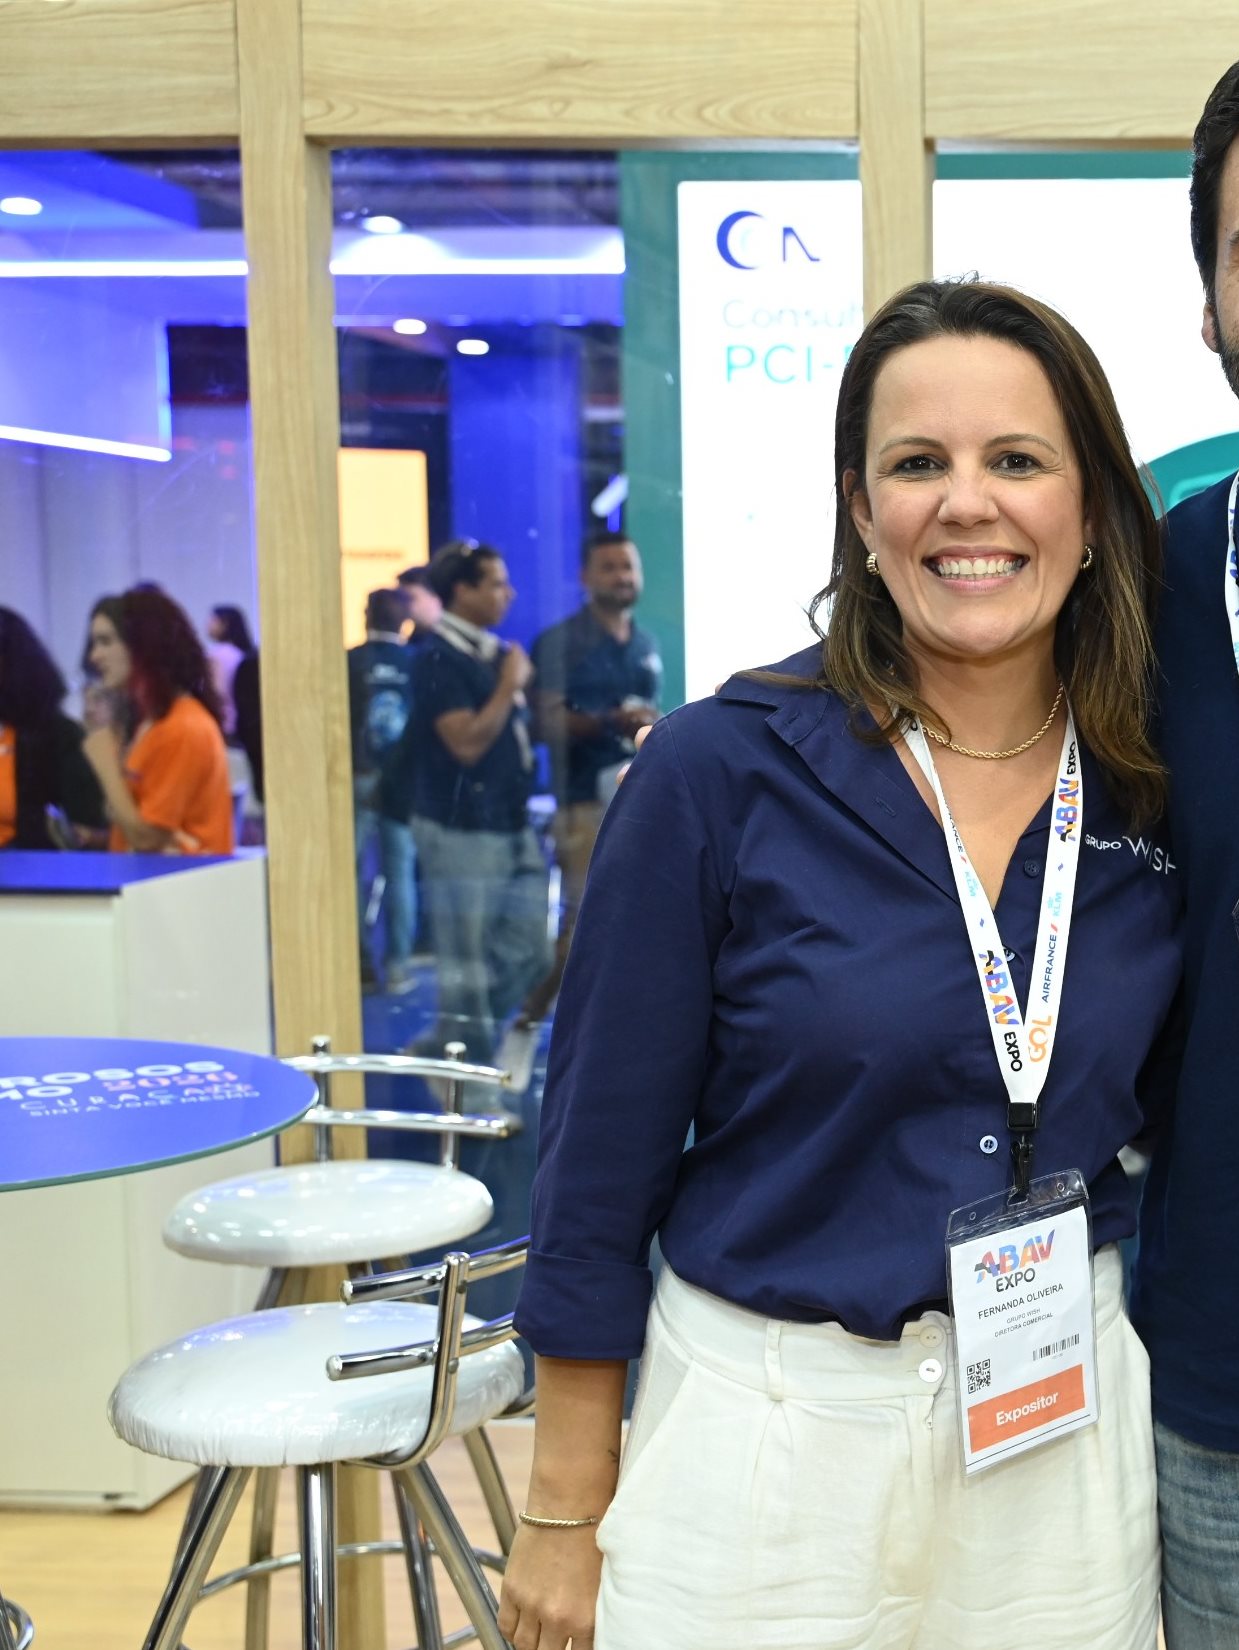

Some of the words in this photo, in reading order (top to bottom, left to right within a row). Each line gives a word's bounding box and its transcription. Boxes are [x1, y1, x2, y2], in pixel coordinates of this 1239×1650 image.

[723, 299, 862, 328] Consul
[1055, 778, 1079, 842] ABAV
[1085, 834, 1121, 850] GRUPO
[978, 950, 1020, 1025] ABAV
[1041, 934, 1057, 1003] AIRFRANCE
[1004, 1031, 1022, 1072] EXPO
[1028, 1015, 1052, 1063] GOL
[974, 1229, 1055, 1284] ABAV
[996, 1268, 1036, 1292] EXPO
[978, 1297, 1024, 1319] FERNANDA
[1026, 1283, 1063, 1303] OLIVEIRA
[994, 1323, 1021, 1338] DIRETORA
[1022, 1312, 1053, 1327] COMERCIAL
[996, 1392, 1058, 1426] Expositor
